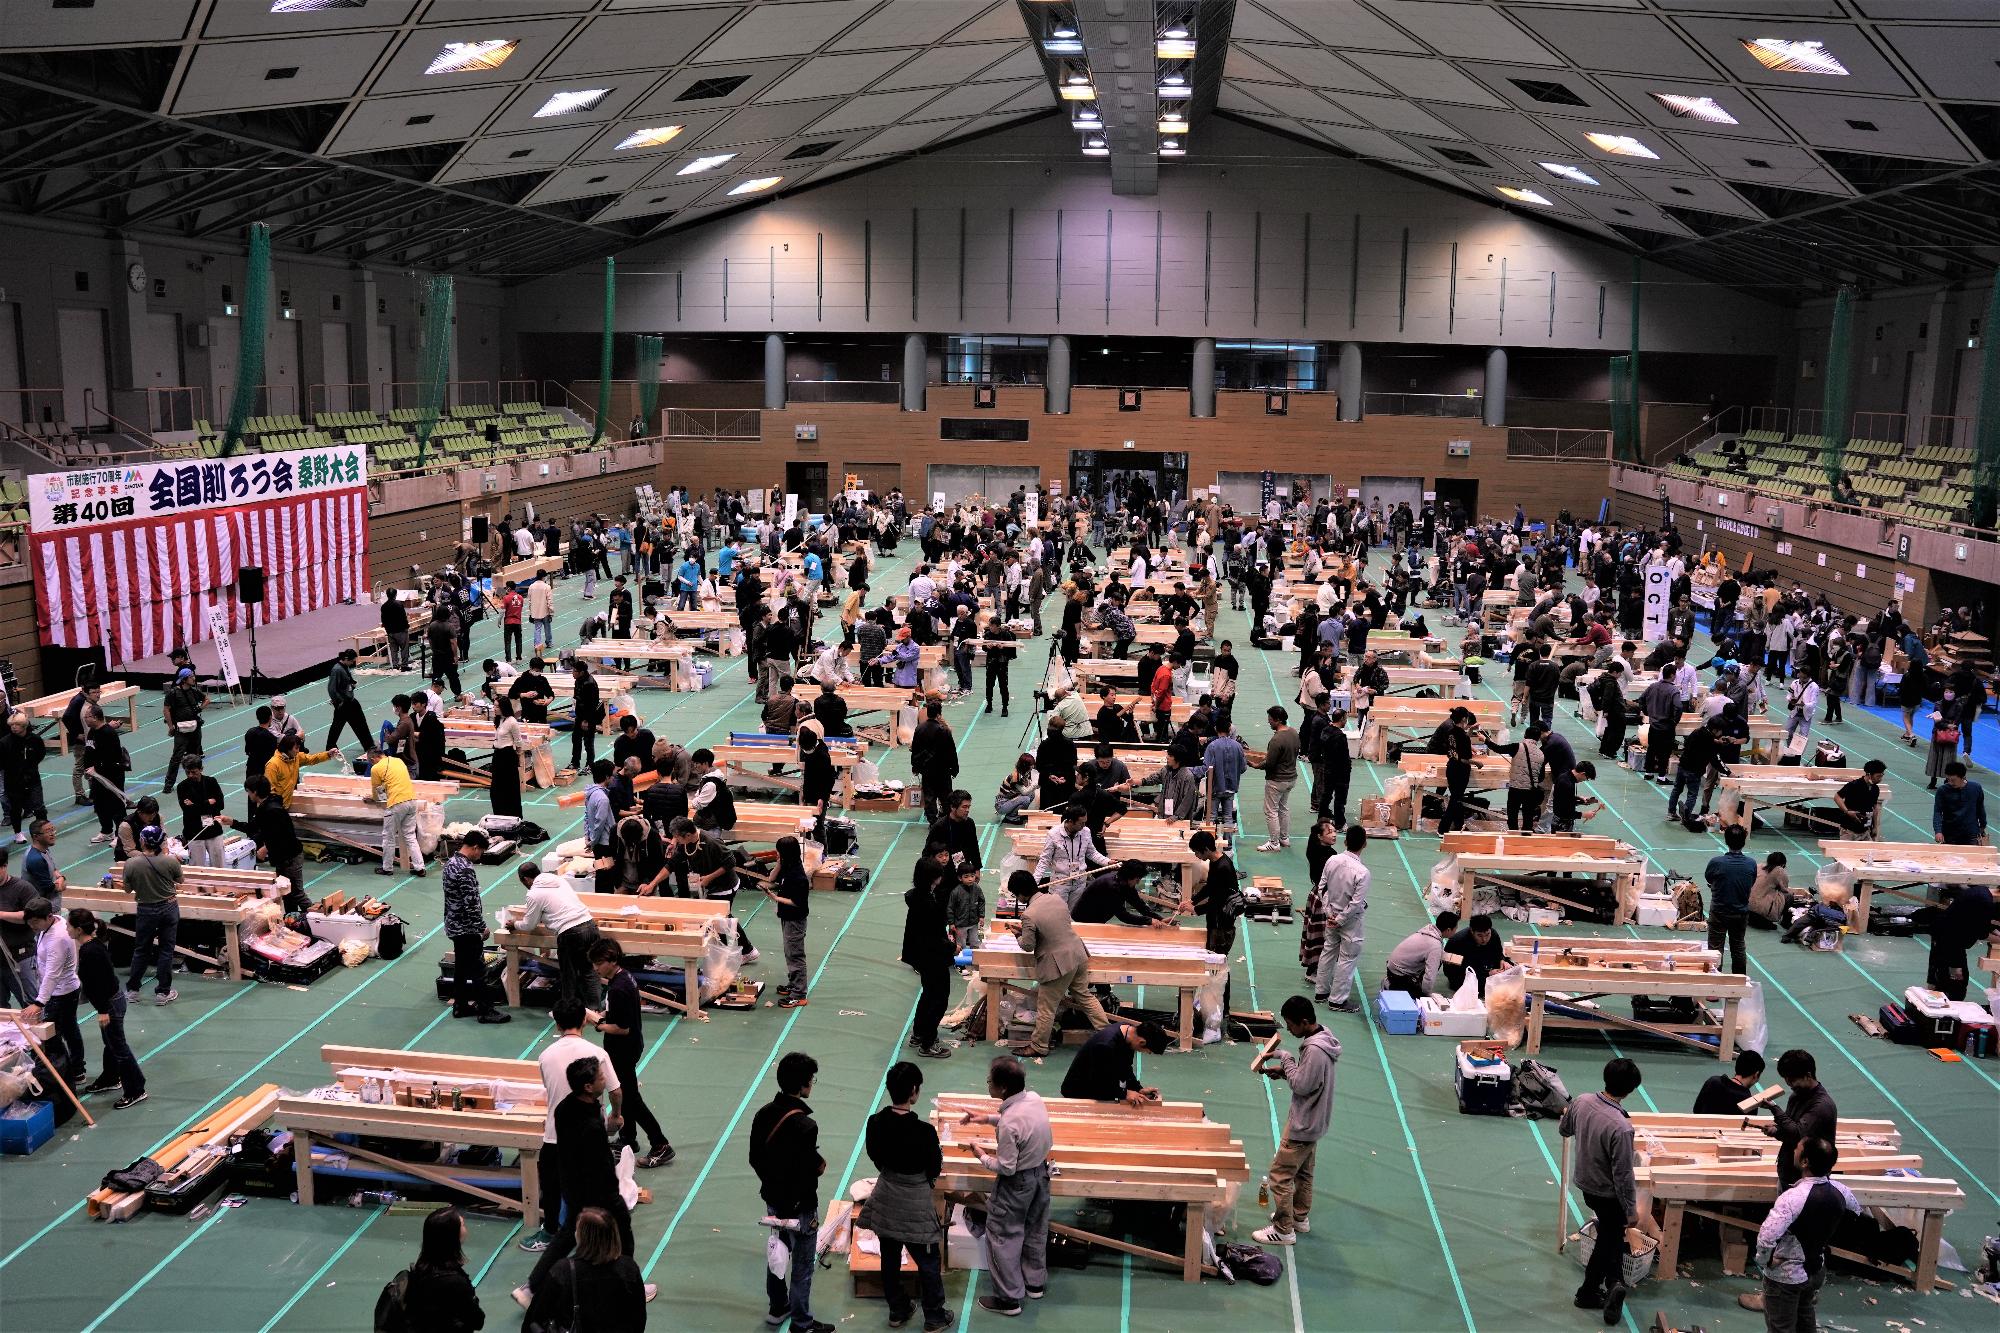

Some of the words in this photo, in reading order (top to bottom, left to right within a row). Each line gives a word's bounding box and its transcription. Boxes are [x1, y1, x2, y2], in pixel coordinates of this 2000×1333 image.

[52, 495, 135, 525] 第40回
[148, 457, 293, 510] 全国削ろう会
[298, 450, 359, 489] 秦野大会
[66, 469, 122, 487] 市制施行70周年
[70, 484, 120, 500] 記念事業
[1647, 572, 1663, 624] OCT
